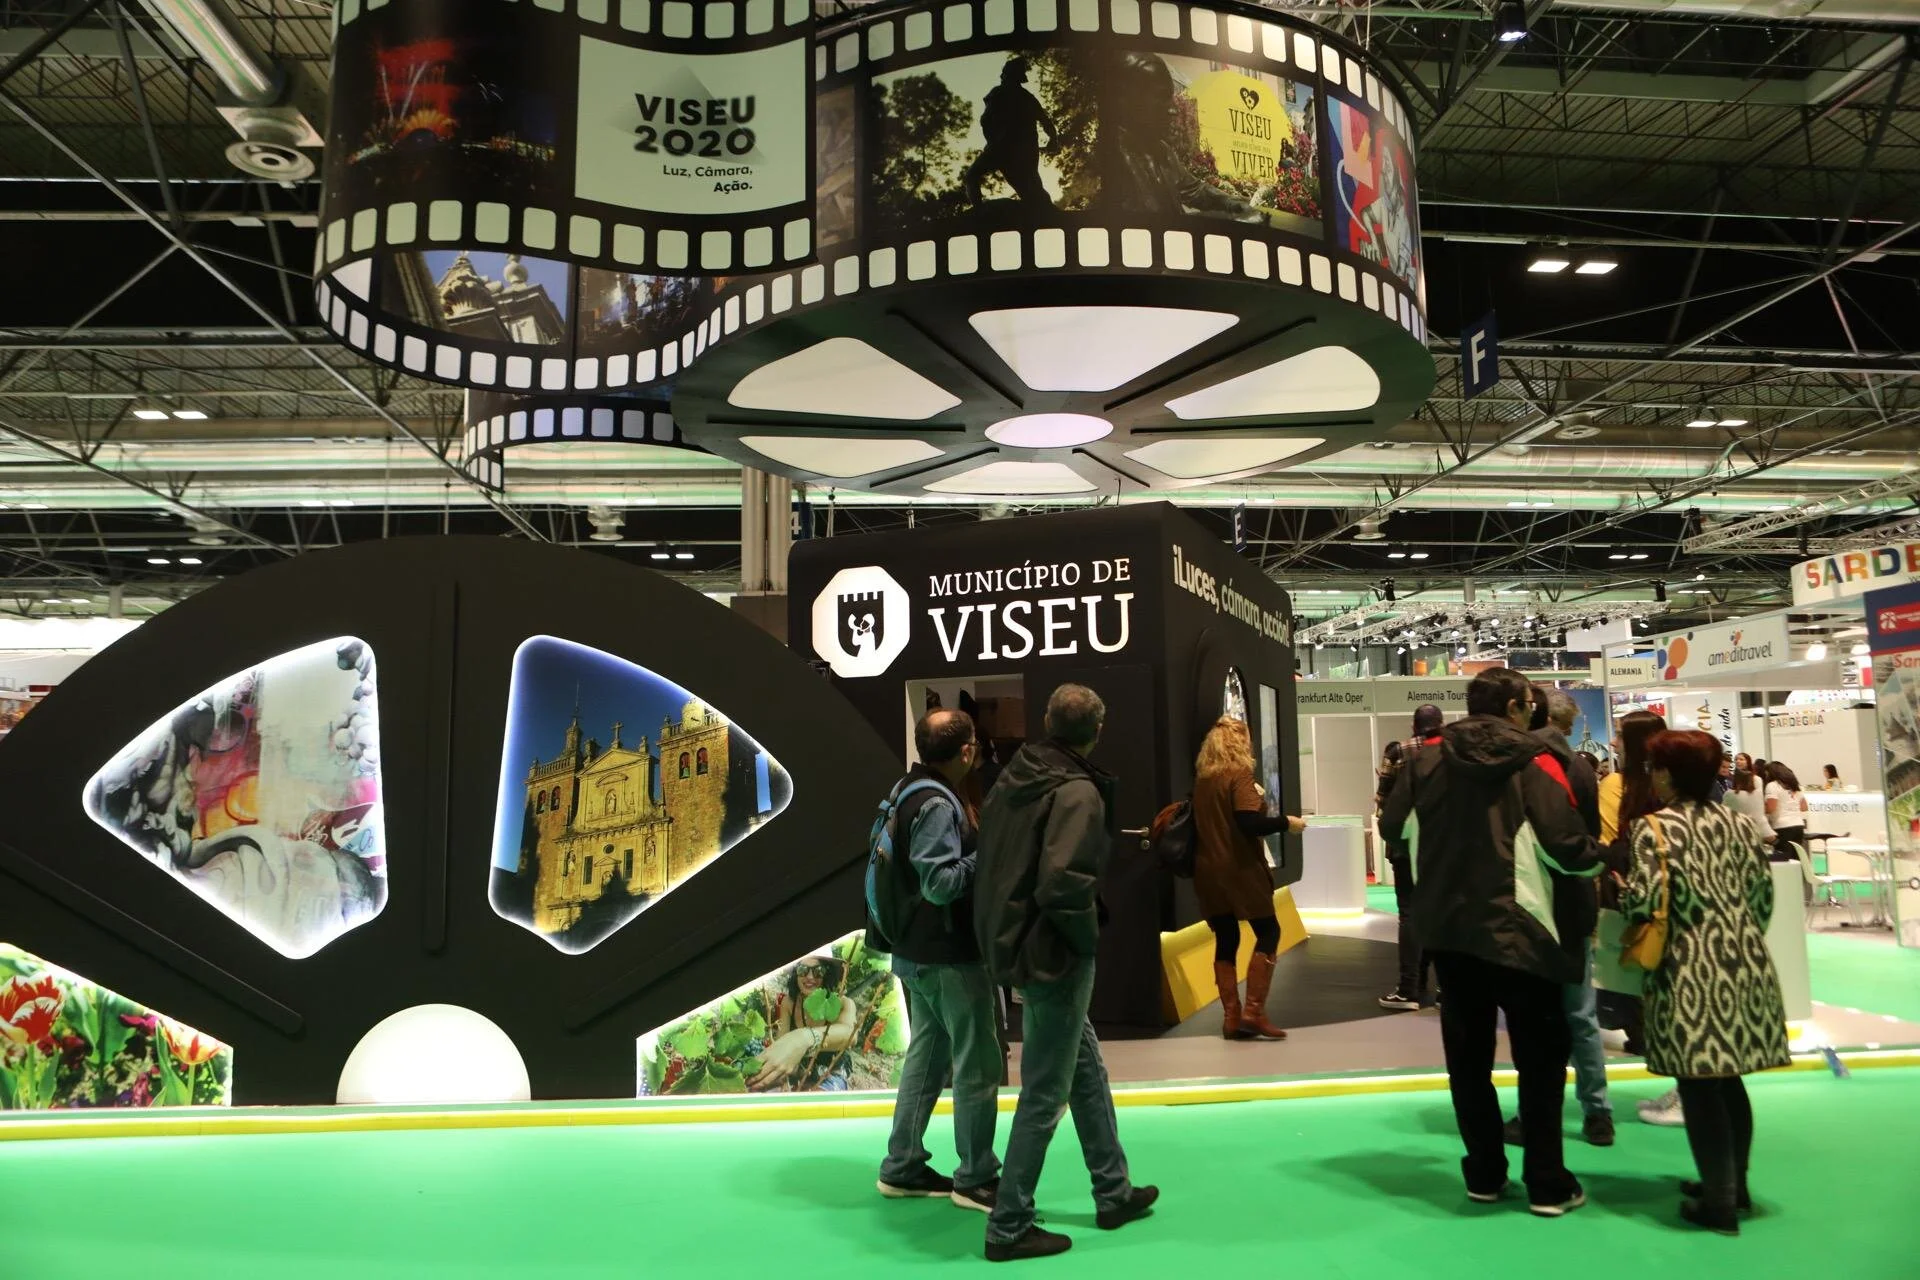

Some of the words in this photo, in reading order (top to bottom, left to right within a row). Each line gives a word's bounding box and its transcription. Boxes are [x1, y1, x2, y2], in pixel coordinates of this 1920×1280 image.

[634, 93, 756, 126] VISEU
[1228, 108, 1272, 141] VISEU
[634, 124, 756, 157] 2020
[662, 164, 691, 178] Luz,
[695, 165, 753, 178] Câmara,
[1231, 149, 1275, 179] VIVER
[713, 180, 753, 195] Ação.
[1470, 329, 1486, 385] F
[1234, 511, 1243, 545] E
[929, 560, 1081, 598] MUNICÍPIO
[1092, 557, 1131, 584] DE
[1221, 577, 1262, 638] cámara,
[927, 592, 1135, 662] VISEU
[1708, 640, 1773, 667] ameditravel
[1610, 667, 1642, 676] ALEMANIA
[1296, 692, 1327, 704] rankfurt
[1328, 692, 1344, 703] Alte
[1345, 692, 1364, 704] Oper
[1407, 690, 1445, 701] Alemania
[1767, 713, 1825, 730] SARDEGNA
